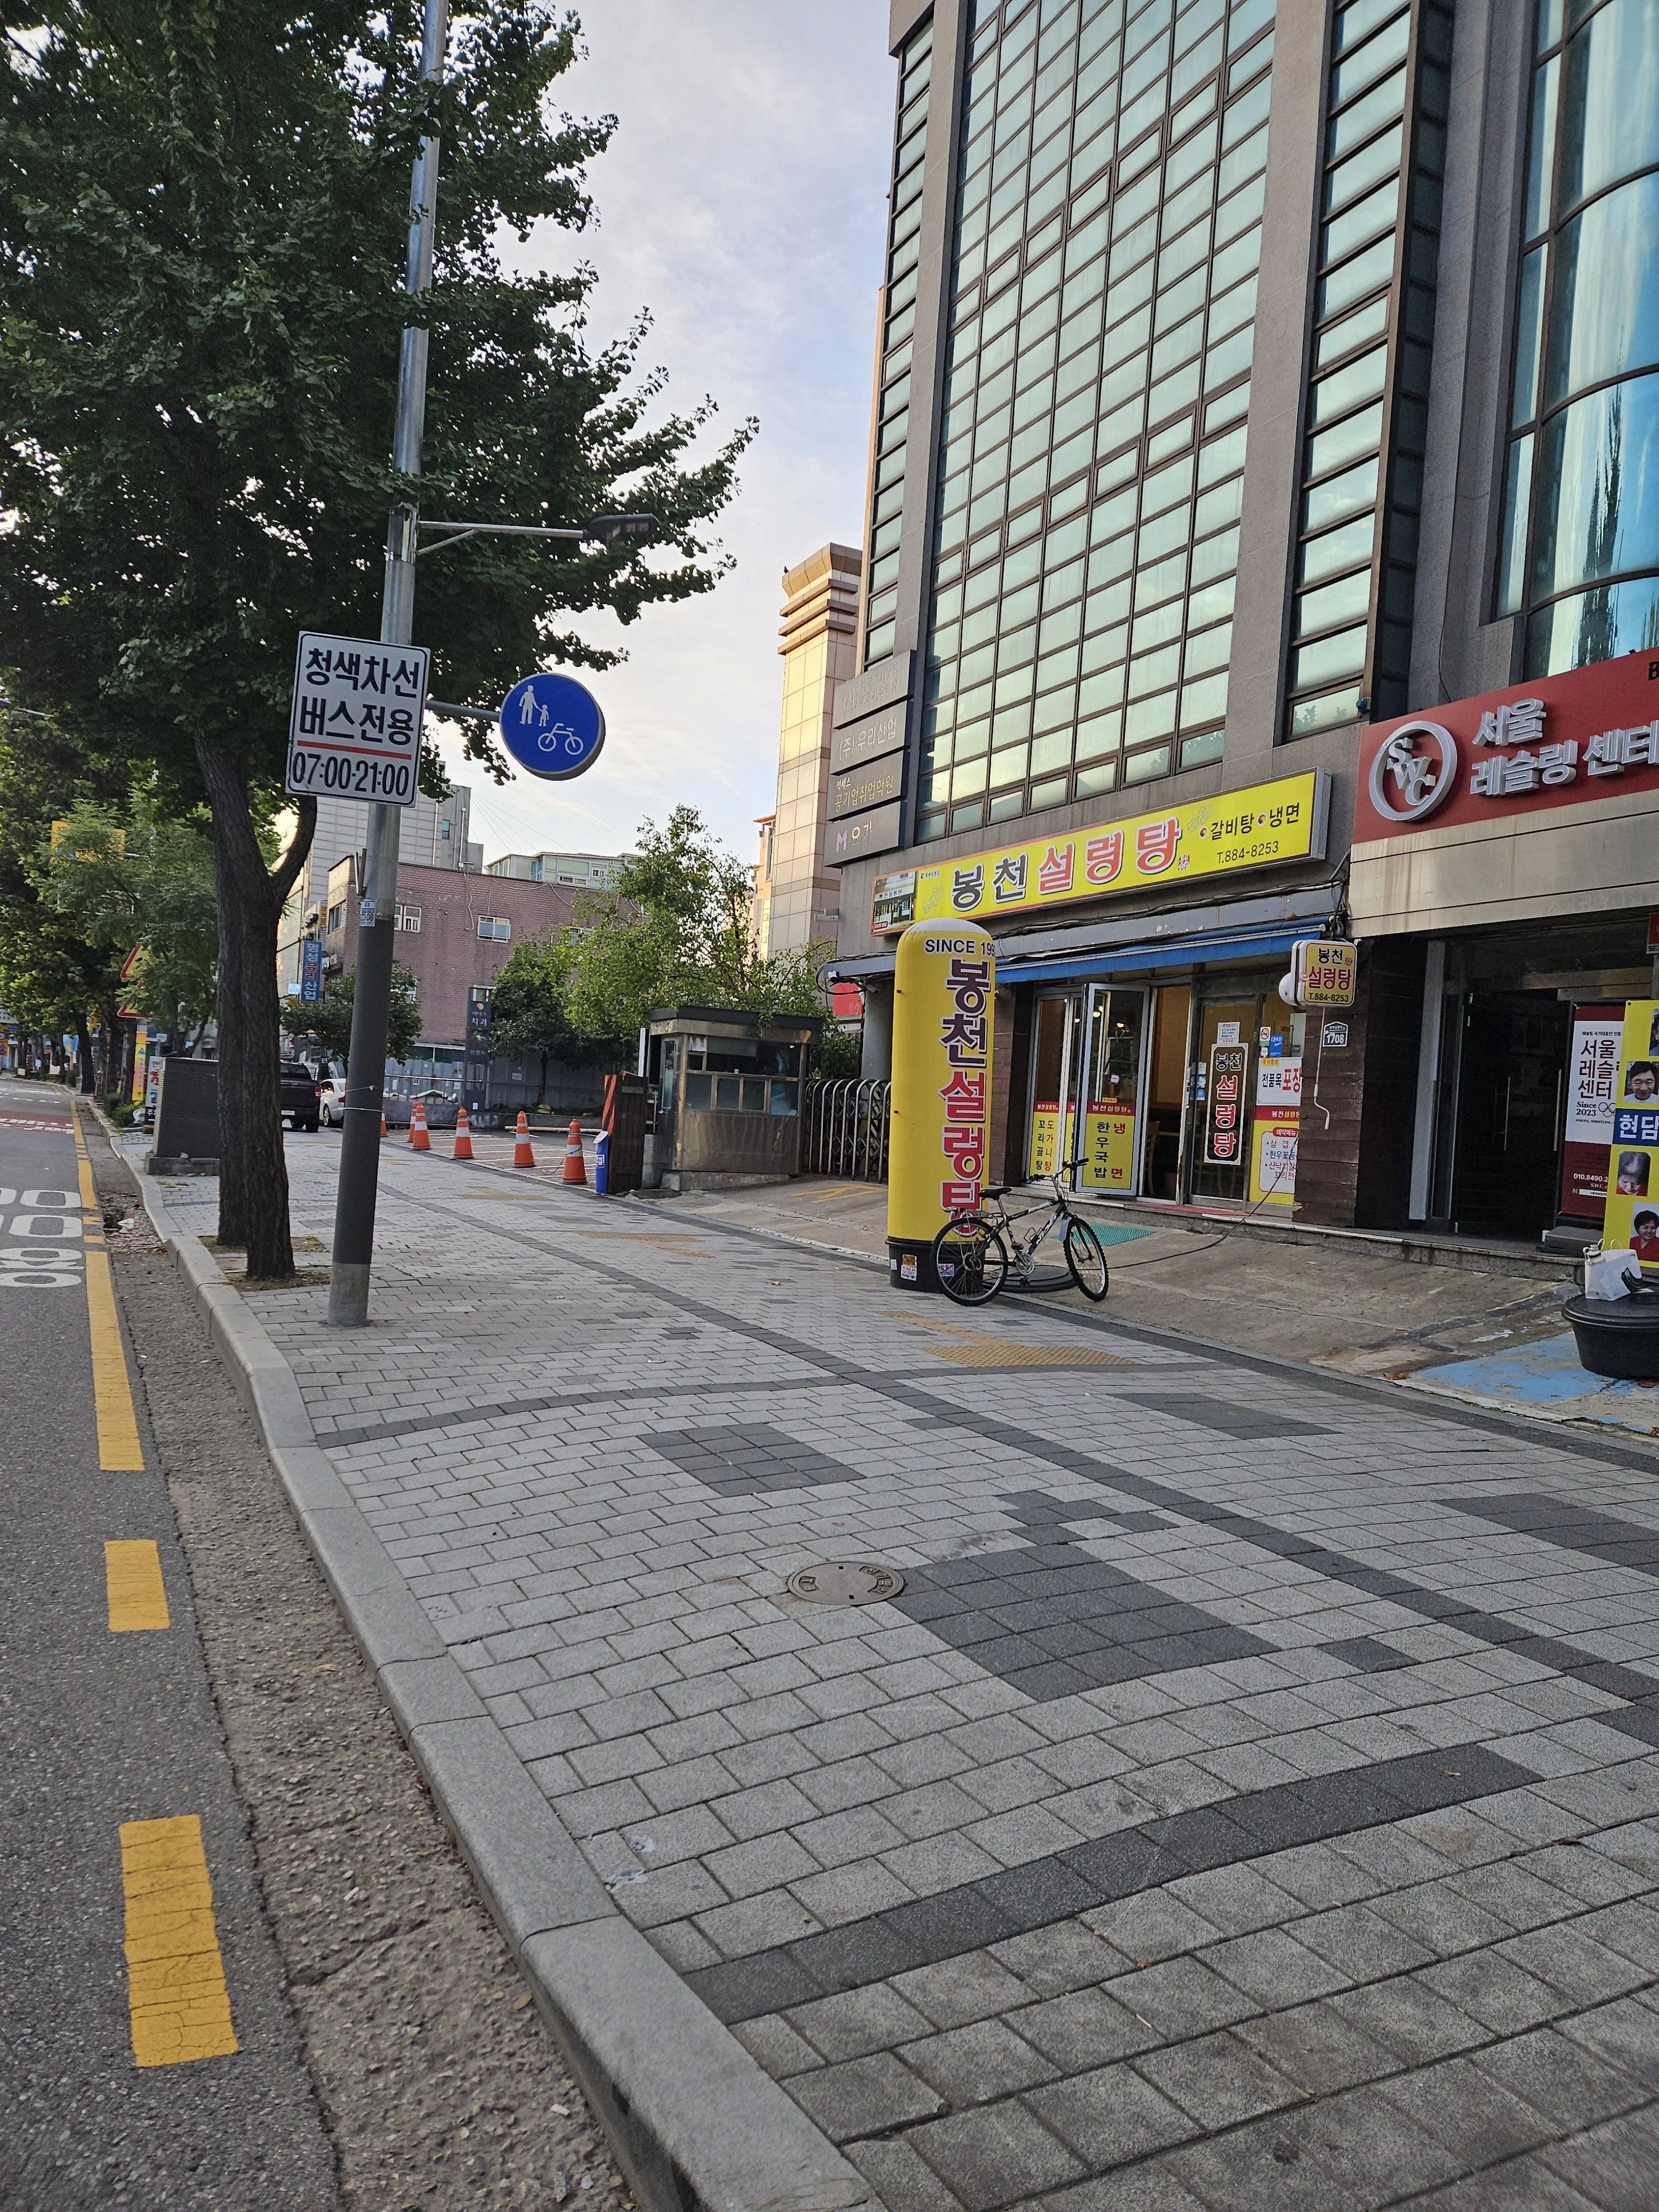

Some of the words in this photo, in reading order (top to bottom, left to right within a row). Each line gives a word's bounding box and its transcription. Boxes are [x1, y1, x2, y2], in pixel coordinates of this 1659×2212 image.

[305, 648, 419, 698] 청색차선
[299, 695, 414, 745] 버스전용
[1472, 698, 1547, 745] 서울
[839, 734, 854, 760] (주)
[856, 717, 897, 752] 우리산업
[1470, 739, 1579, 795] 레슬링
[1582, 719, 1659, 776] 센터
[834, 774, 894, 813] 공기업취업학원
[836, 776, 851, 791] 석세스
[1211, 813, 1255, 841] 갈비탕
[1269, 802, 1300, 828] 냉면
[836, 830, 848, 853] M
[851, 820, 873, 847] 요가
[951, 816, 1182, 911] 봉천설렁탕
[1217, 841, 1279, 864] T.884-8253
[925, 939, 975, 953] SINCE
[981, 942, 995, 957] 199
[1318, 948, 1343, 964] 봉천
[304, 943, 319, 1000] 명성유리산업
[1308, 966, 1352, 990] 설렁탕
[1308, 993, 1349, 1003] T.884-8253
[471, 1018, 487, 1027] 치과
[1327, 1034, 1345, 1045] 1708
[1580, 1039, 1616, 1059] 서울
[1215, 1053, 1243, 1072] 봉천
[1261, 1073, 1282, 1088] 전품목
[1282, 1068, 1301, 1093] 포장
[1578, 1079, 1613, 1100] 센터
[1092, 1104, 1128, 1113] 봉천설렁탕
[1214, 1074, 1238, 1157] 설렁탕
[1576, 1108, 1597, 1117] 2023
[1045, 1120, 1055, 1171] 도가니탕
[1094, 1121, 1110, 1179] 한우국밥
[1269, 1150, 1297, 1160] 한우꽃등
